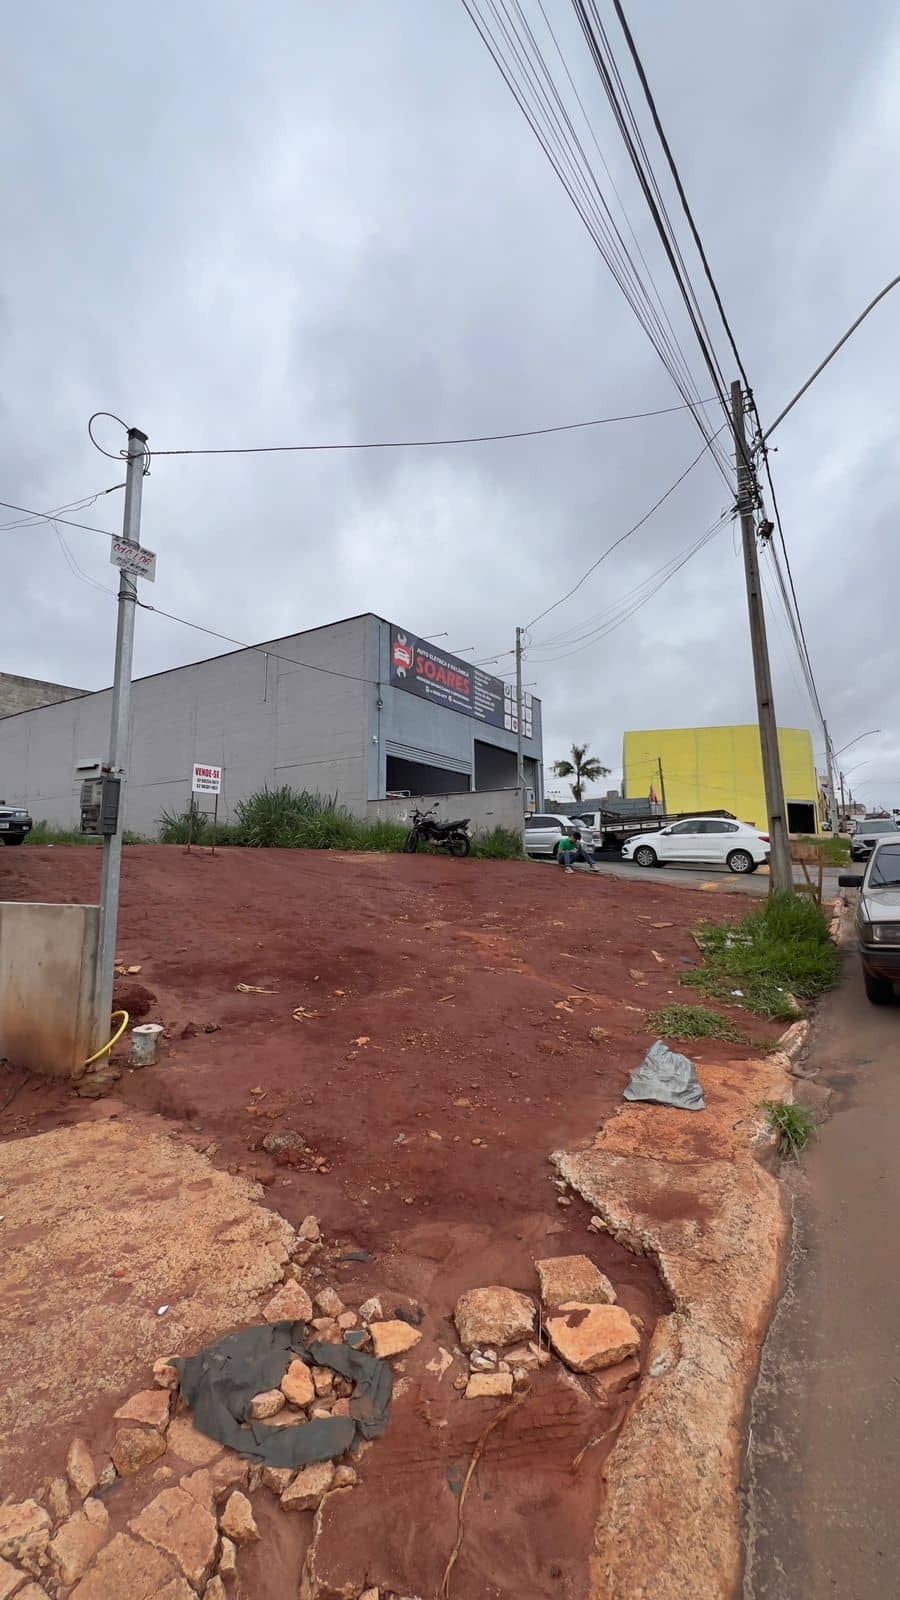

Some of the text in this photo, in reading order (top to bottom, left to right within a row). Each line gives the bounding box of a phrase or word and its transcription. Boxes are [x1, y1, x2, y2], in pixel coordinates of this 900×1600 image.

[417, 648, 429, 658] AUTO
[416, 656, 470, 695] SOARES
[195, 767, 219, 779] VENDE-SE
